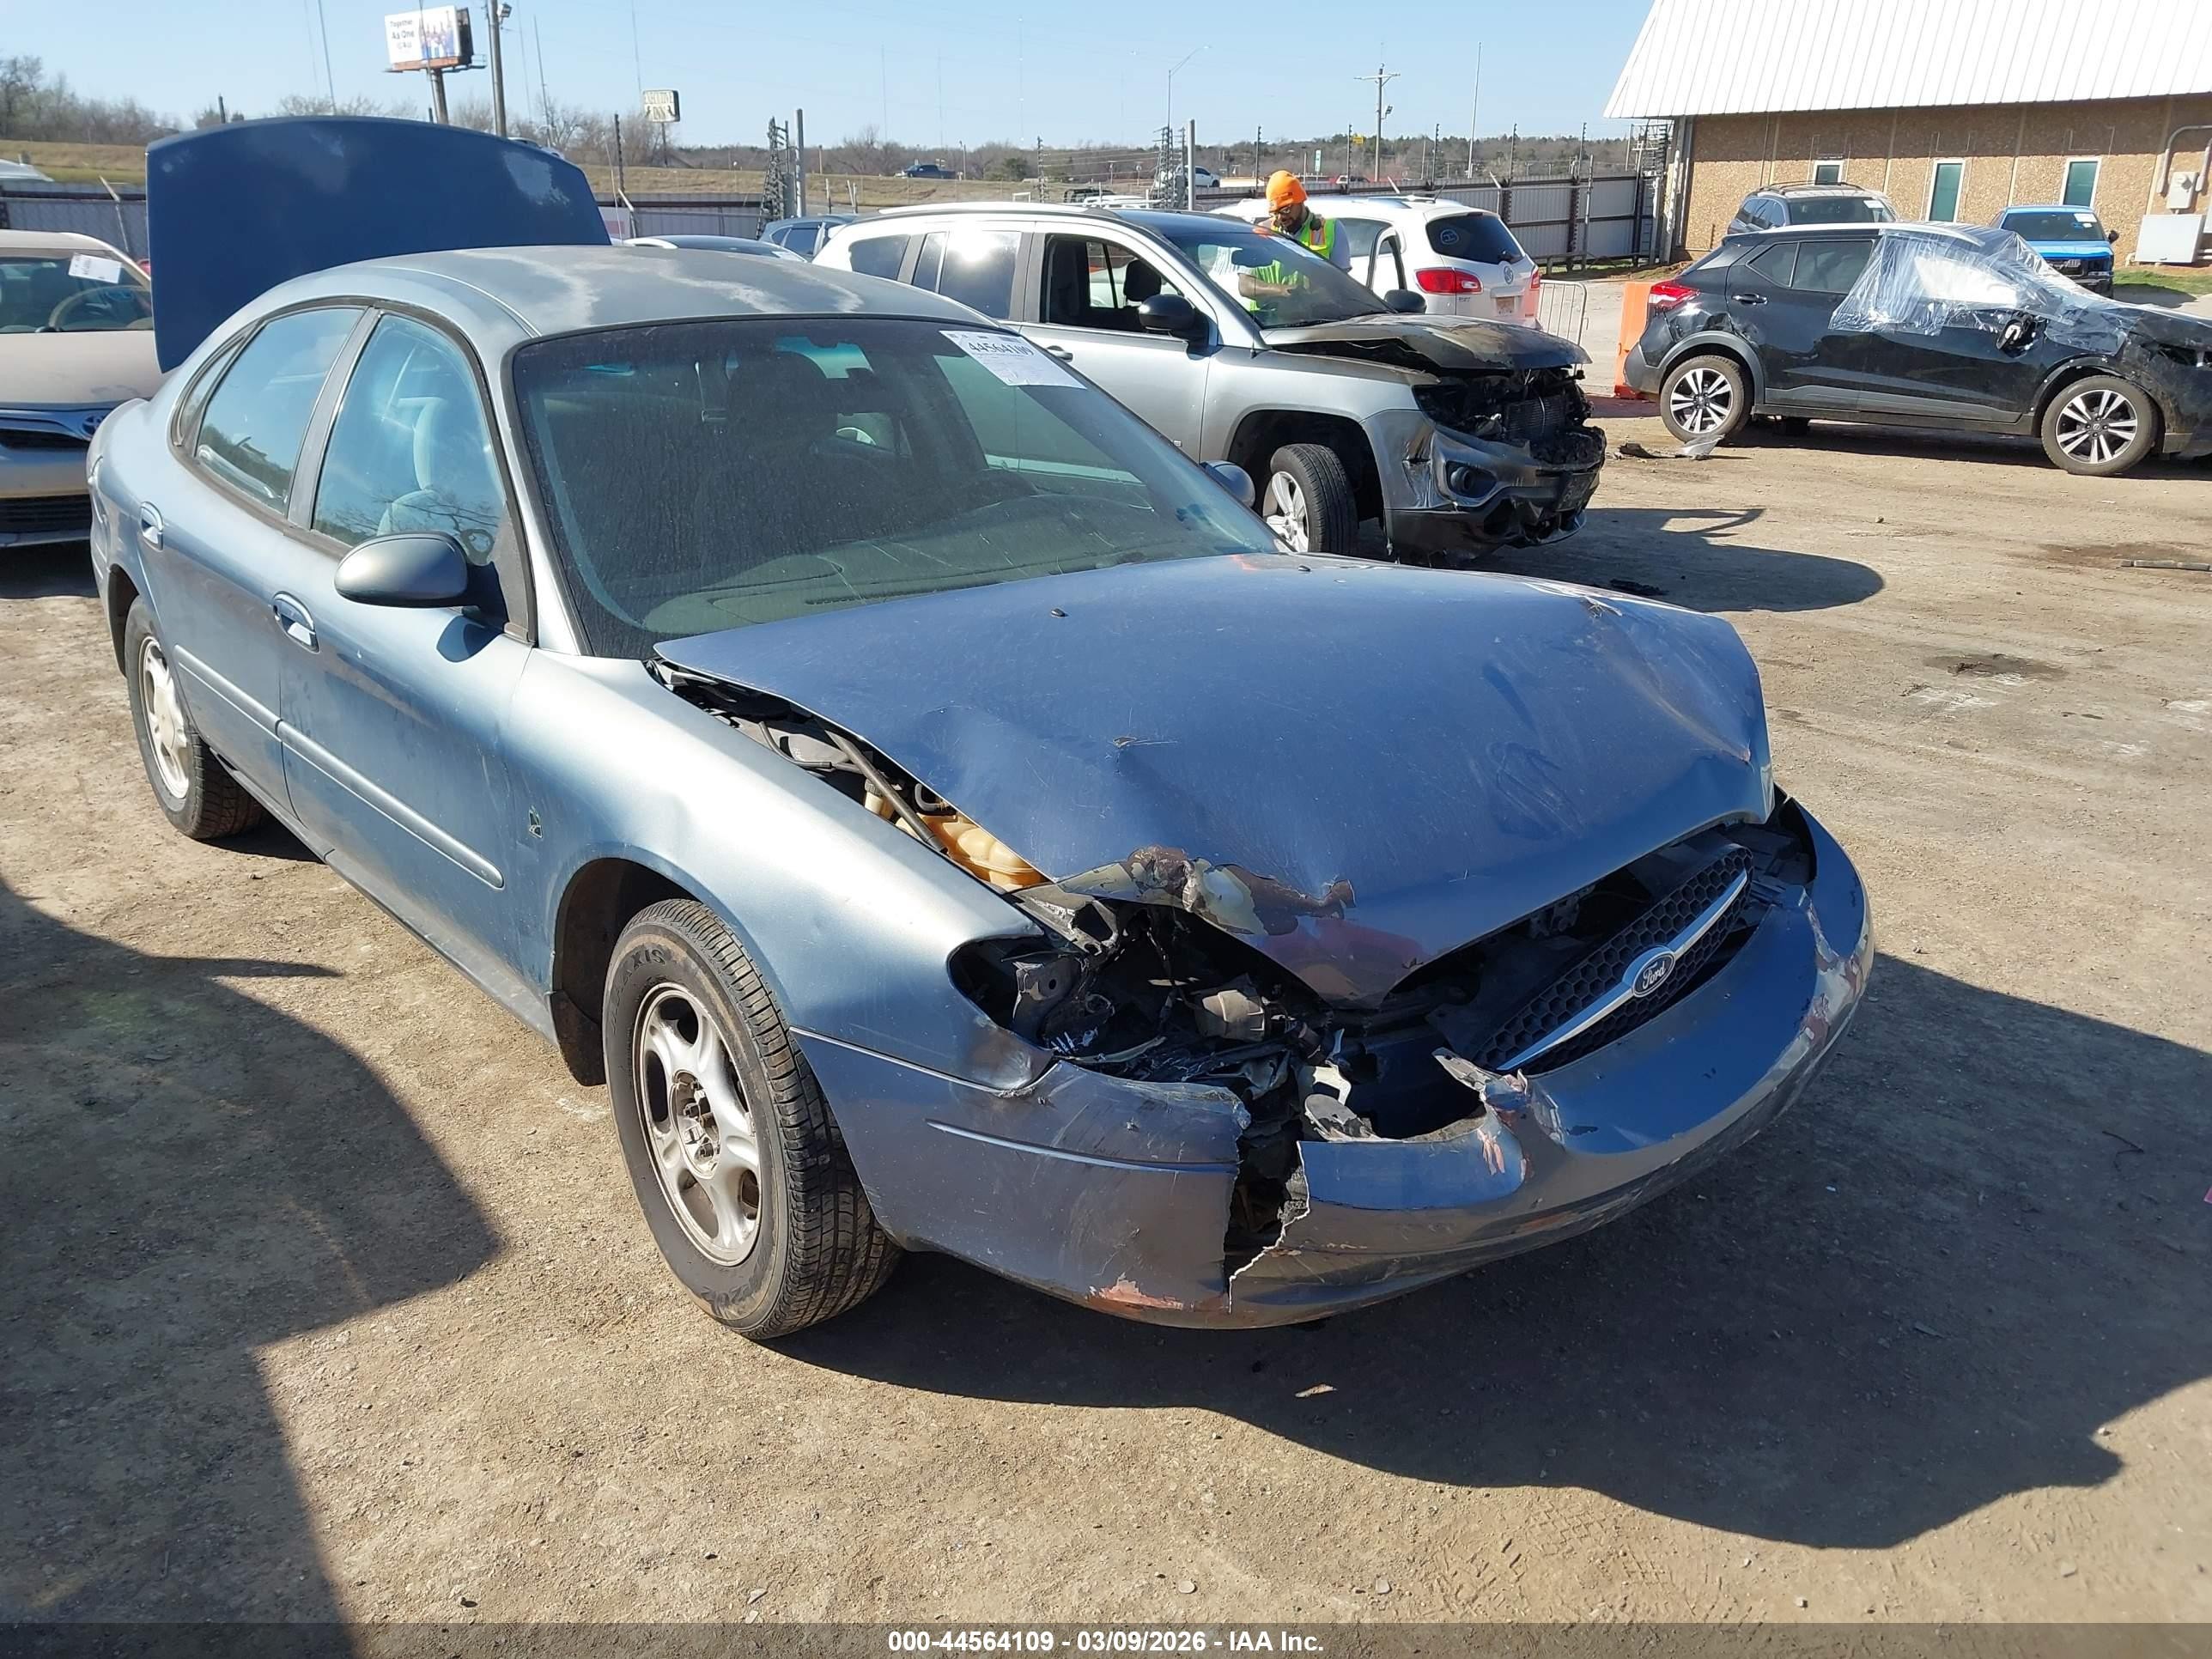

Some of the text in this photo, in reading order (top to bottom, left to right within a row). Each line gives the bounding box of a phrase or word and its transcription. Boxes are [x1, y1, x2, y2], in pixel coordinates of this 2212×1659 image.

[401, 30, 415, 39] One
[968, 342, 1035, 356] 44564109
[1642, 960, 1666, 989] Ford
